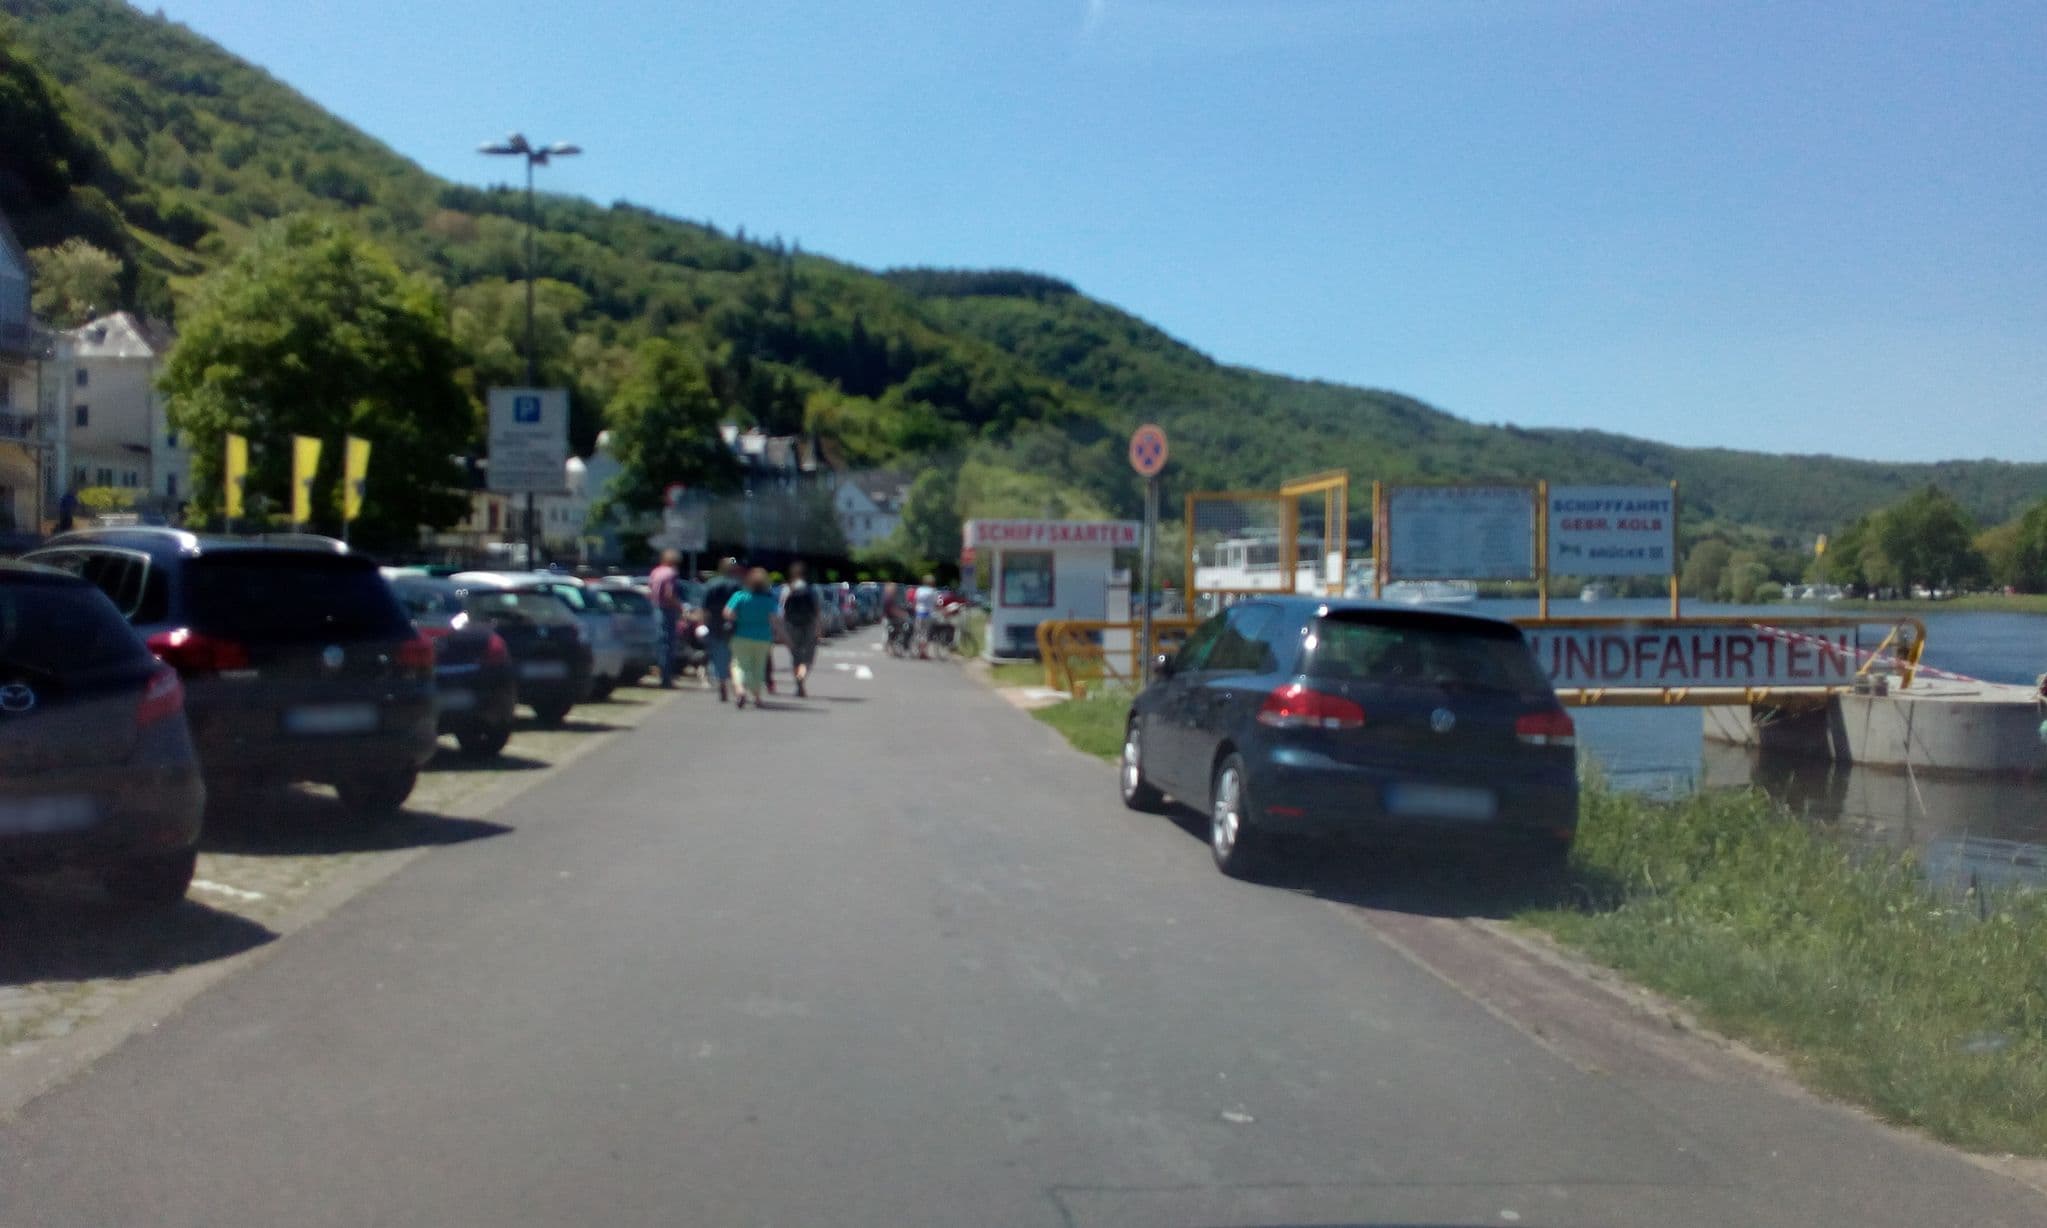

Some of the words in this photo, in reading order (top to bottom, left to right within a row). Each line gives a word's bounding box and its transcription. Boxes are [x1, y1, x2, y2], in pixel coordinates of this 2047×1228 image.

[977, 523, 1134, 542] SCHIFFSKARTEN
[1616, 518, 1662, 531] KOLB
[1531, 635, 1849, 680] UNDFAHRTEN
